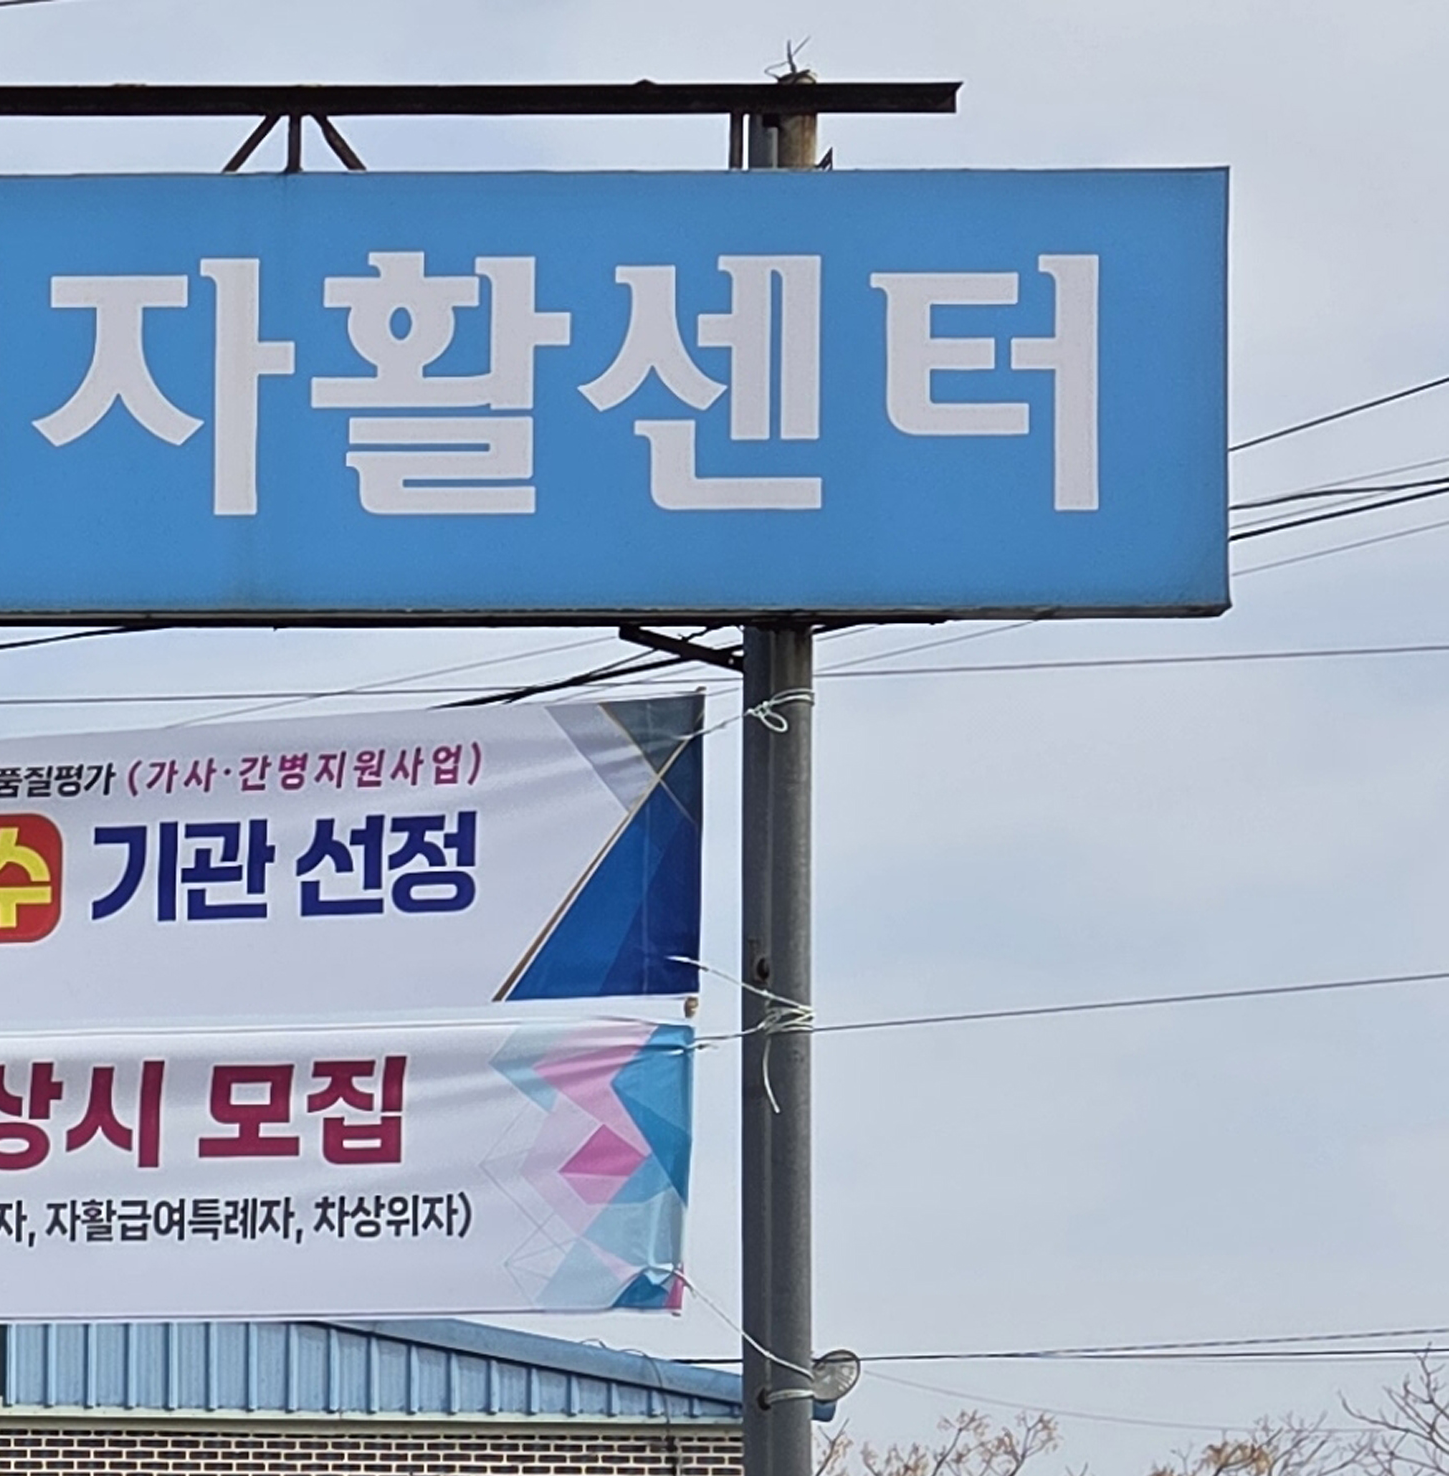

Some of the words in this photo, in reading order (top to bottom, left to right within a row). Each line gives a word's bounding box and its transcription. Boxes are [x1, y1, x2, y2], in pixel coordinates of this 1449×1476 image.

[91, 818, 277, 921] 기관
[294, 809, 478, 915] 선정
[198, 1055, 409, 1166] 모집
[45, 1198, 303, 1244] 자활급여특례자,
[313, 1191, 473, 1239] 차상위자)
